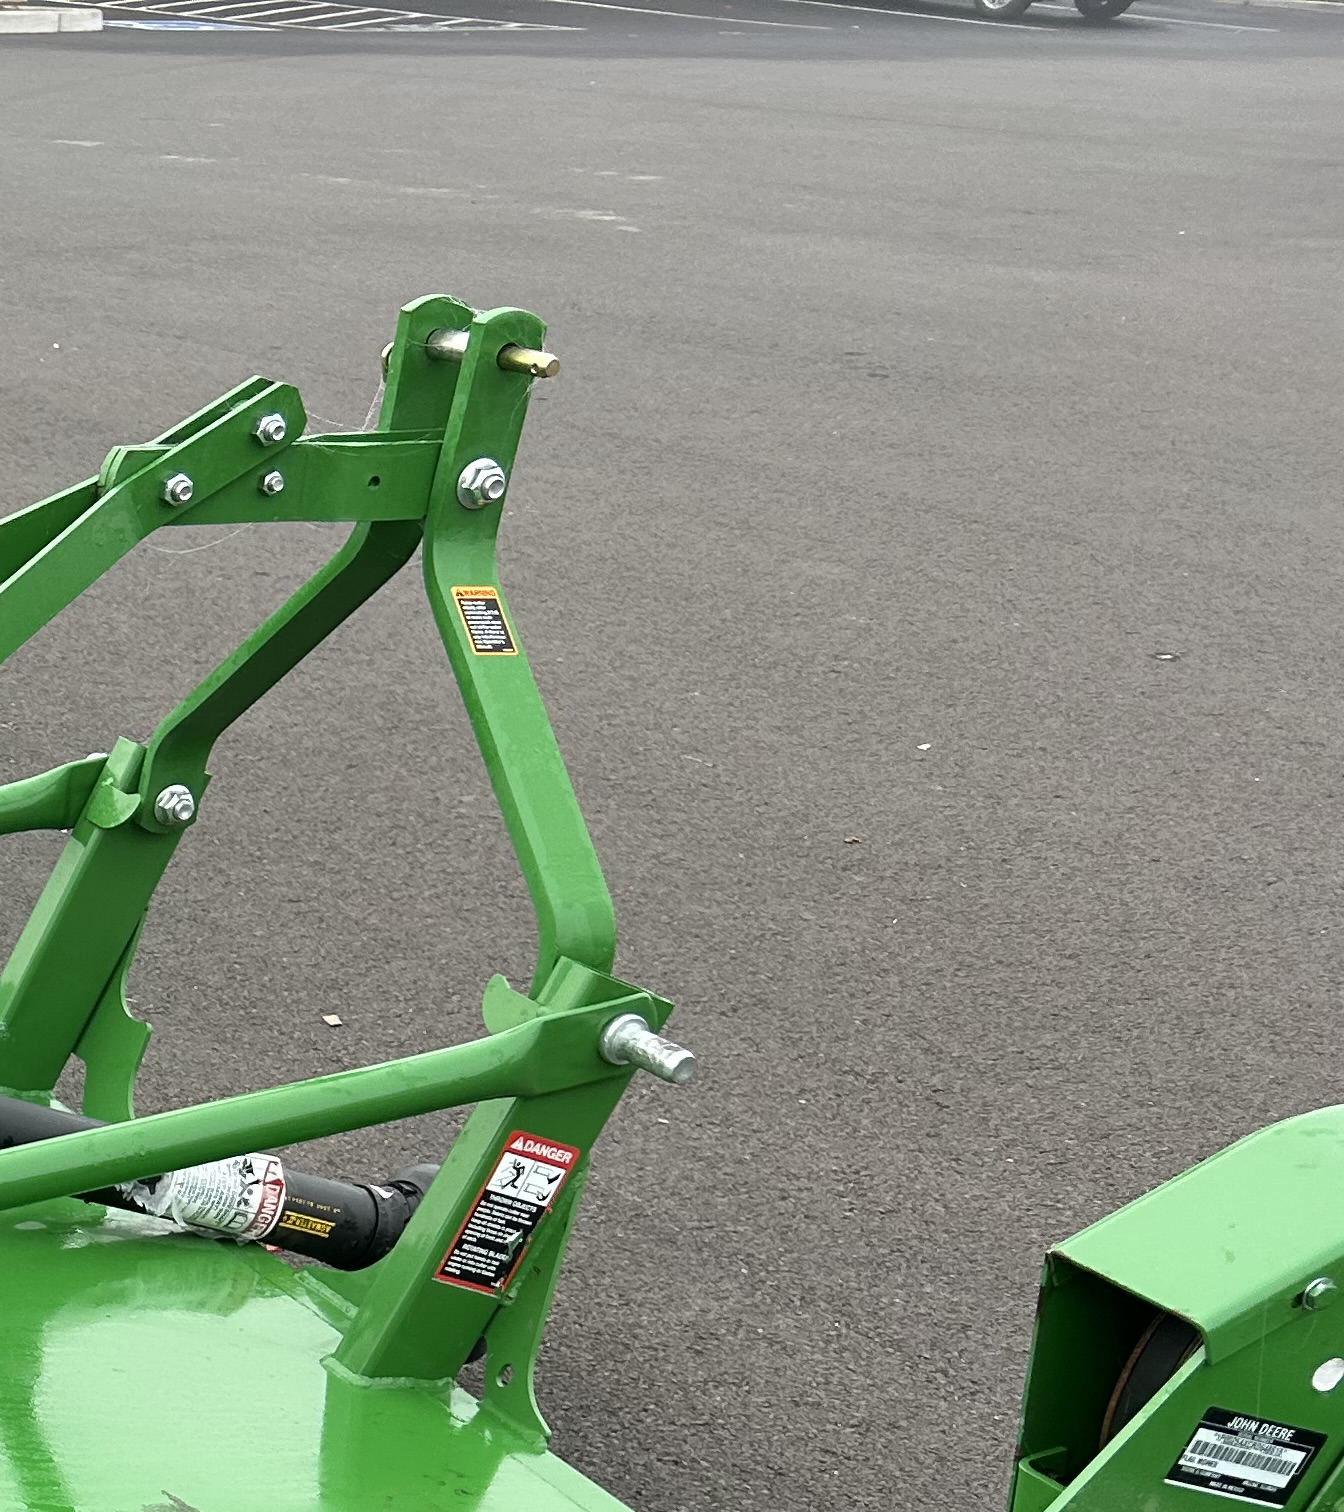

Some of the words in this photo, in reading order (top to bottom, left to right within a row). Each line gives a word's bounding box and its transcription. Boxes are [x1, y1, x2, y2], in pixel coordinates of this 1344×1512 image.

[521, 1140, 574, 1165] DANGER
[1227, 1417, 1259, 1433] JOHN
[1259, 1423, 1296, 1441] DEERE
